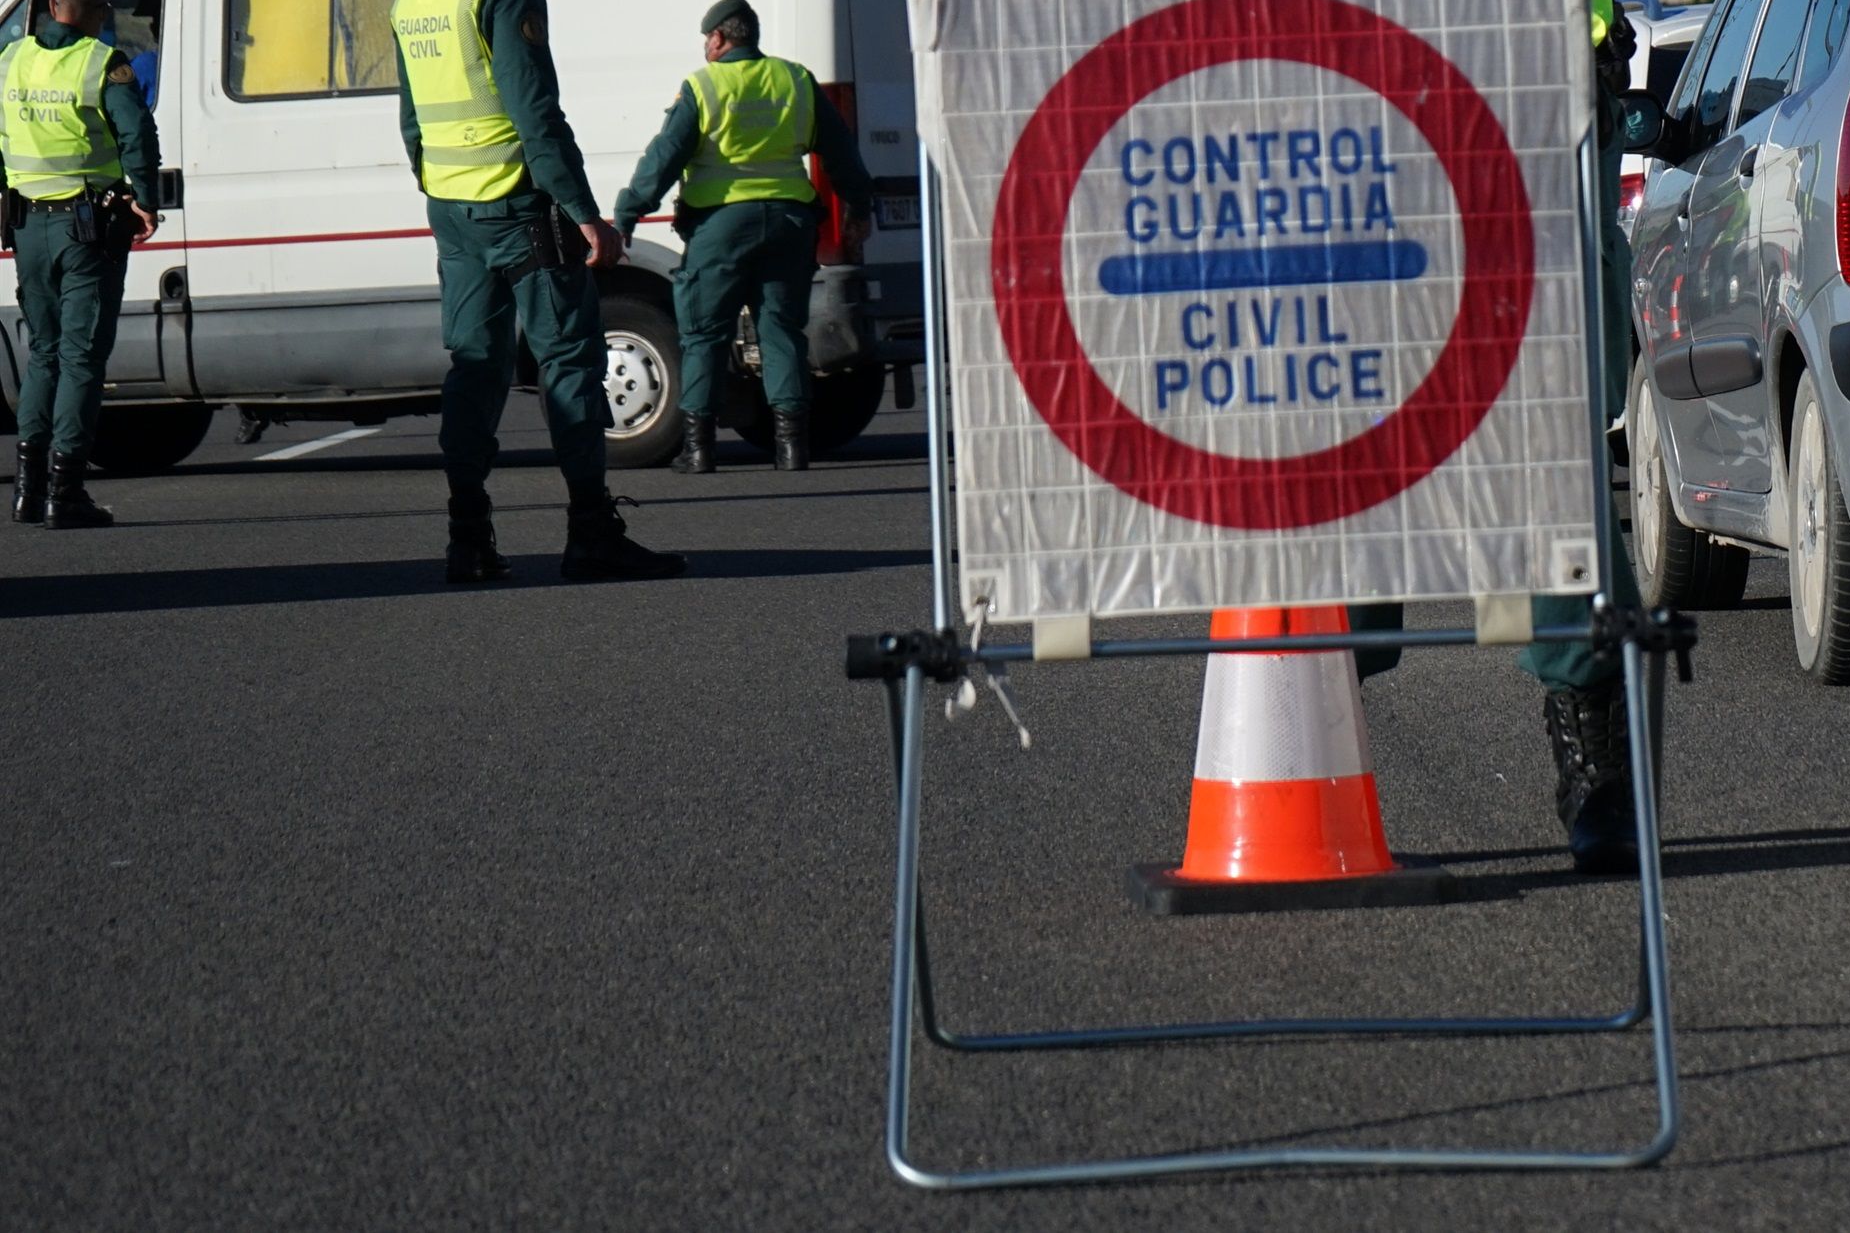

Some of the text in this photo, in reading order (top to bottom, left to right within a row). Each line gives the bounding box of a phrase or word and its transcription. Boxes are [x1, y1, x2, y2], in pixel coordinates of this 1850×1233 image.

[398, 14, 452, 36] GUARDIA
[408, 38, 442, 59] CIVIL
[7, 87, 76, 104] GUARDIA
[19, 106, 63, 123] CIVIL
[1120, 125, 1397, 188] CONTROL
[1124, 181, 1396, 244] GUARDIA
[1181, 295, 1348, 351] CIVIL
[1155, 349, 1385, 411] POLICE
